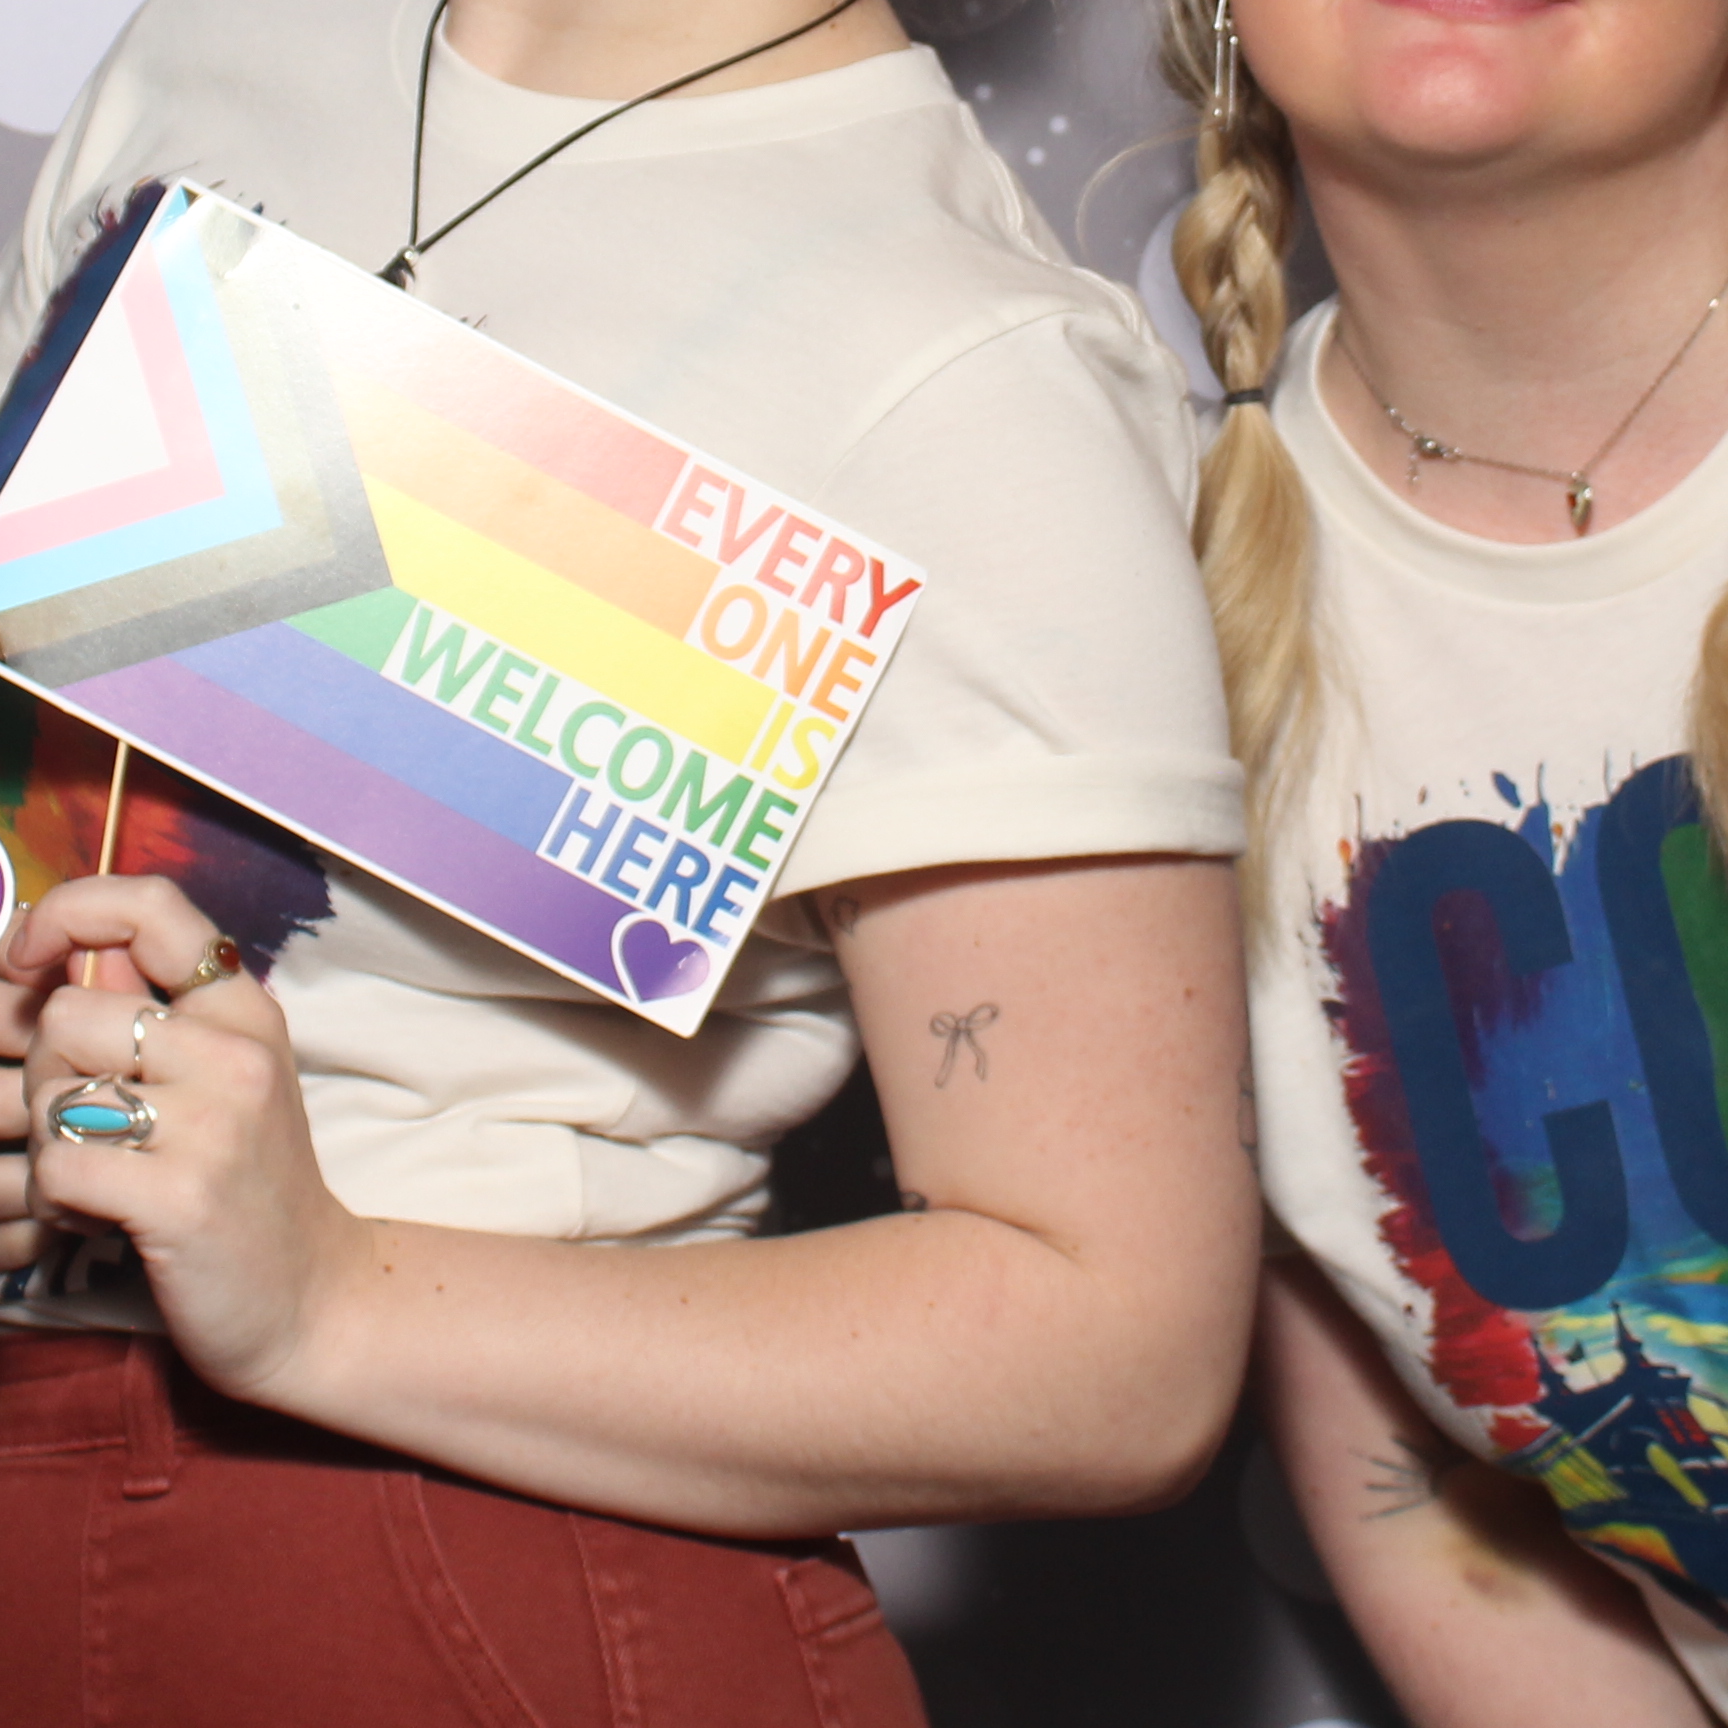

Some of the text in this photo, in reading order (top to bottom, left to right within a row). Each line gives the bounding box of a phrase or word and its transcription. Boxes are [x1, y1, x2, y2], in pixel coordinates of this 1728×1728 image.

[662, 463, 923, 640] EVERY
[700, 582, 878, 723] ONE
[402, 605, 799, 872] WELCOME
[749, 700, 838, 791] IS
[544, 789, 759, 946] HERE
